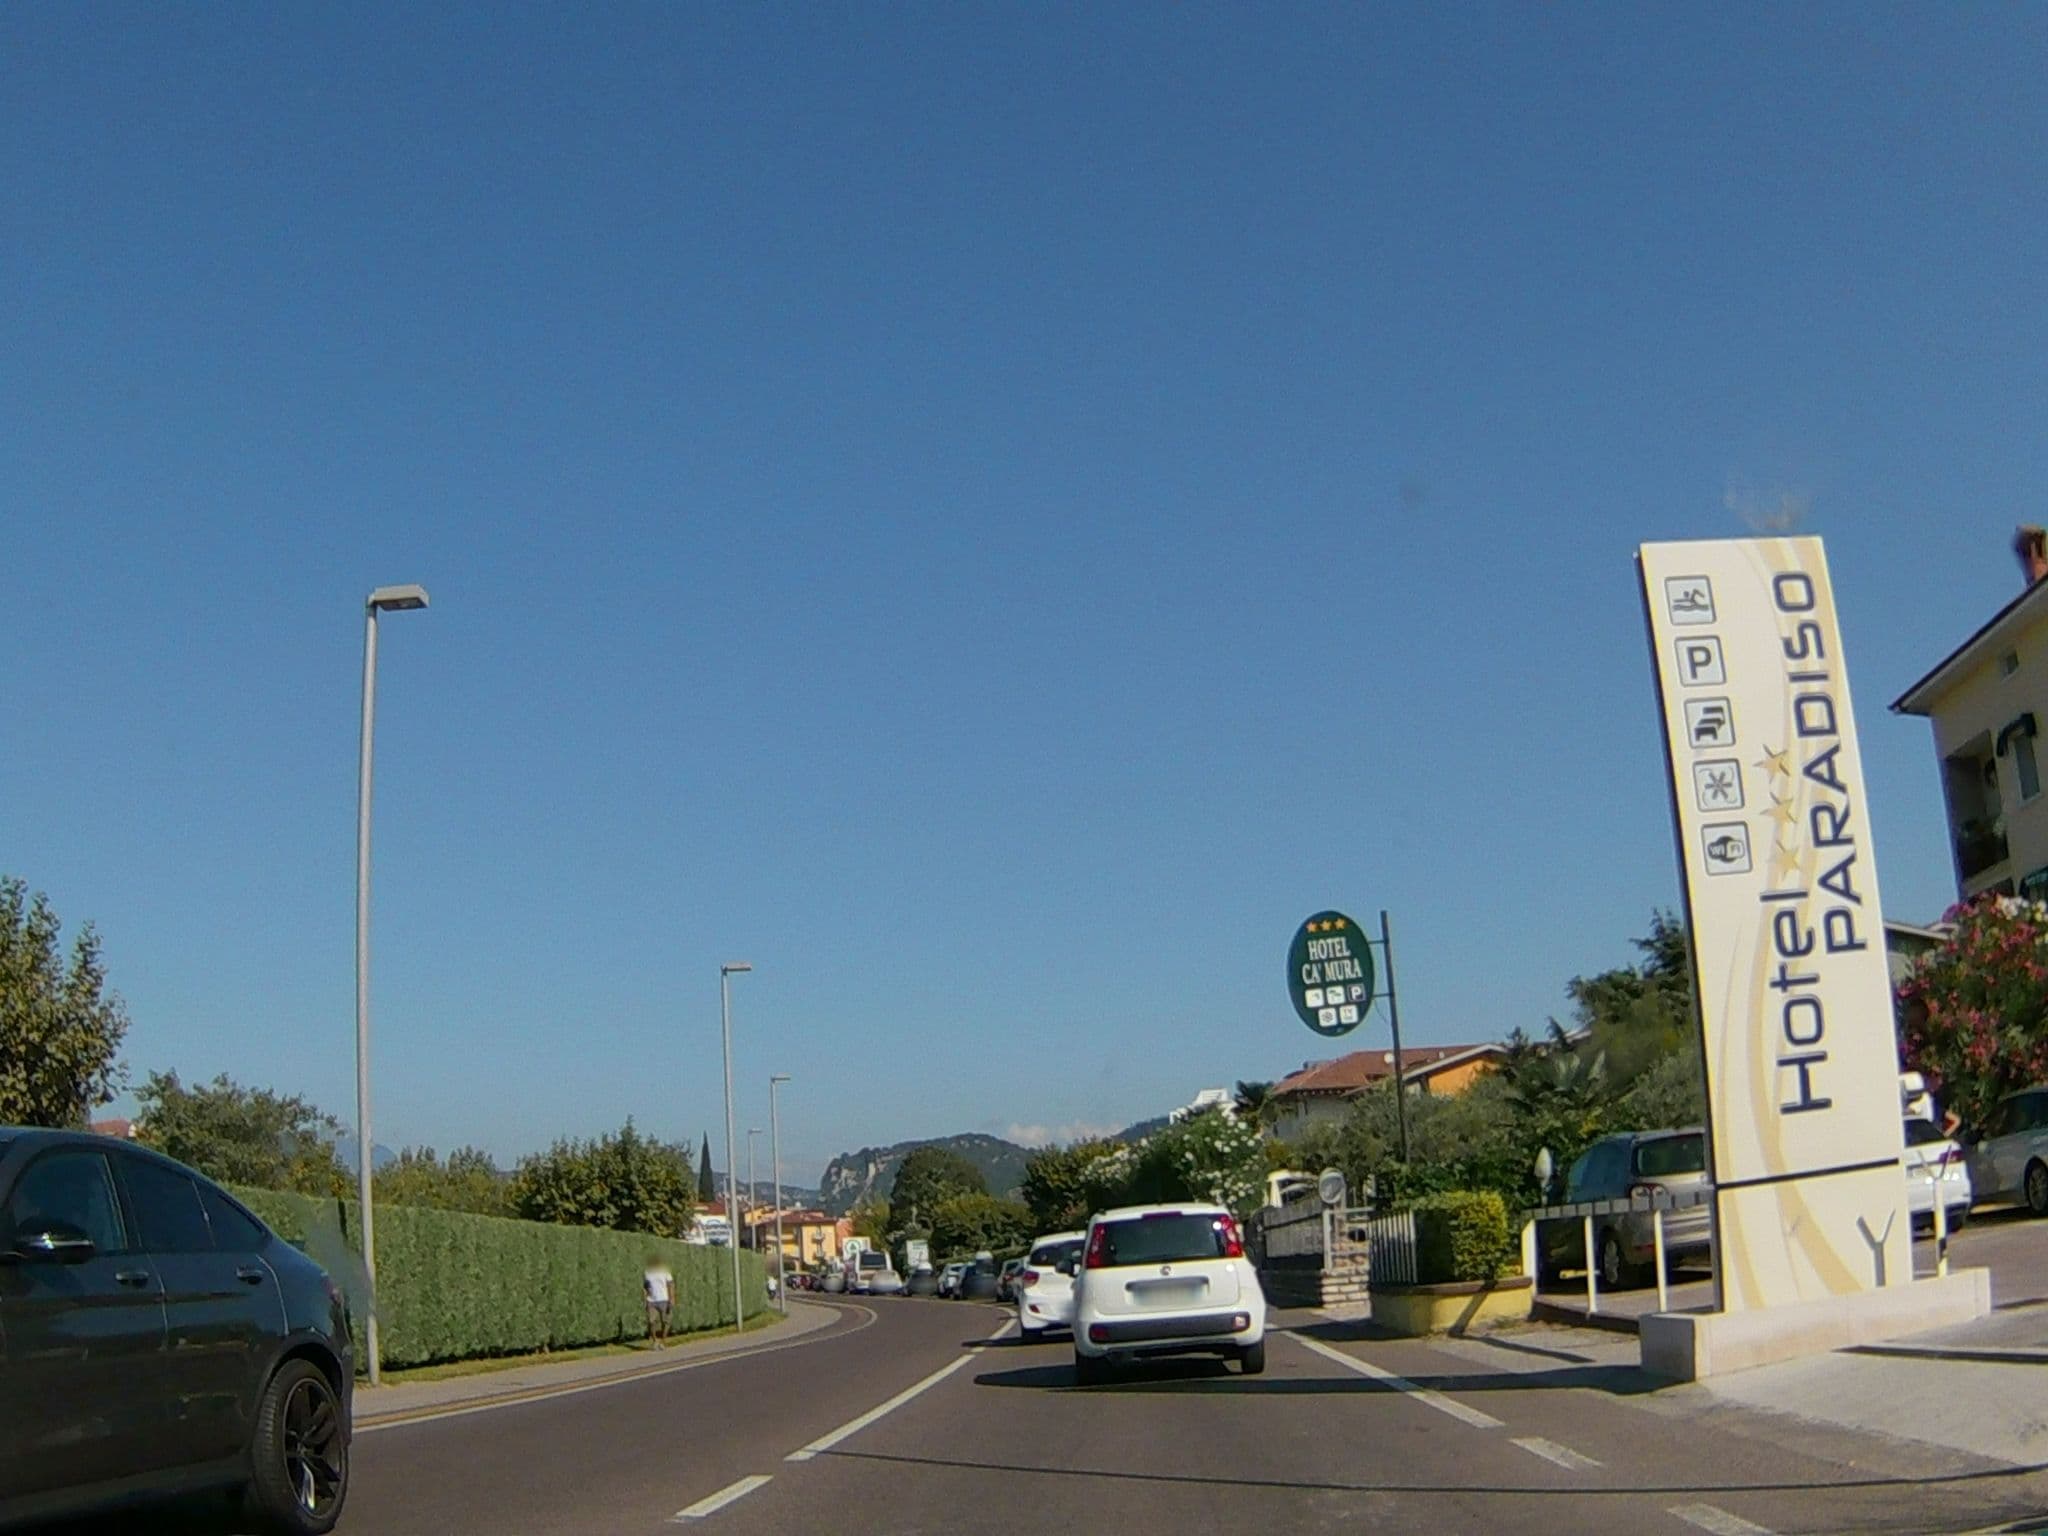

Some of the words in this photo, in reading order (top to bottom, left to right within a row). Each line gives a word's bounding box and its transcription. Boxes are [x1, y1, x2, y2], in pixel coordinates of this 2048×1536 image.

[1687, 646, 1712, 680] P
[1772, 572, 1867, 954] PARADISO
[1307, 936, 1351, 961] HOTEL
[1350, 985, 1362, 1000] P
[1759, 888, 1832, 1115] Hotel
